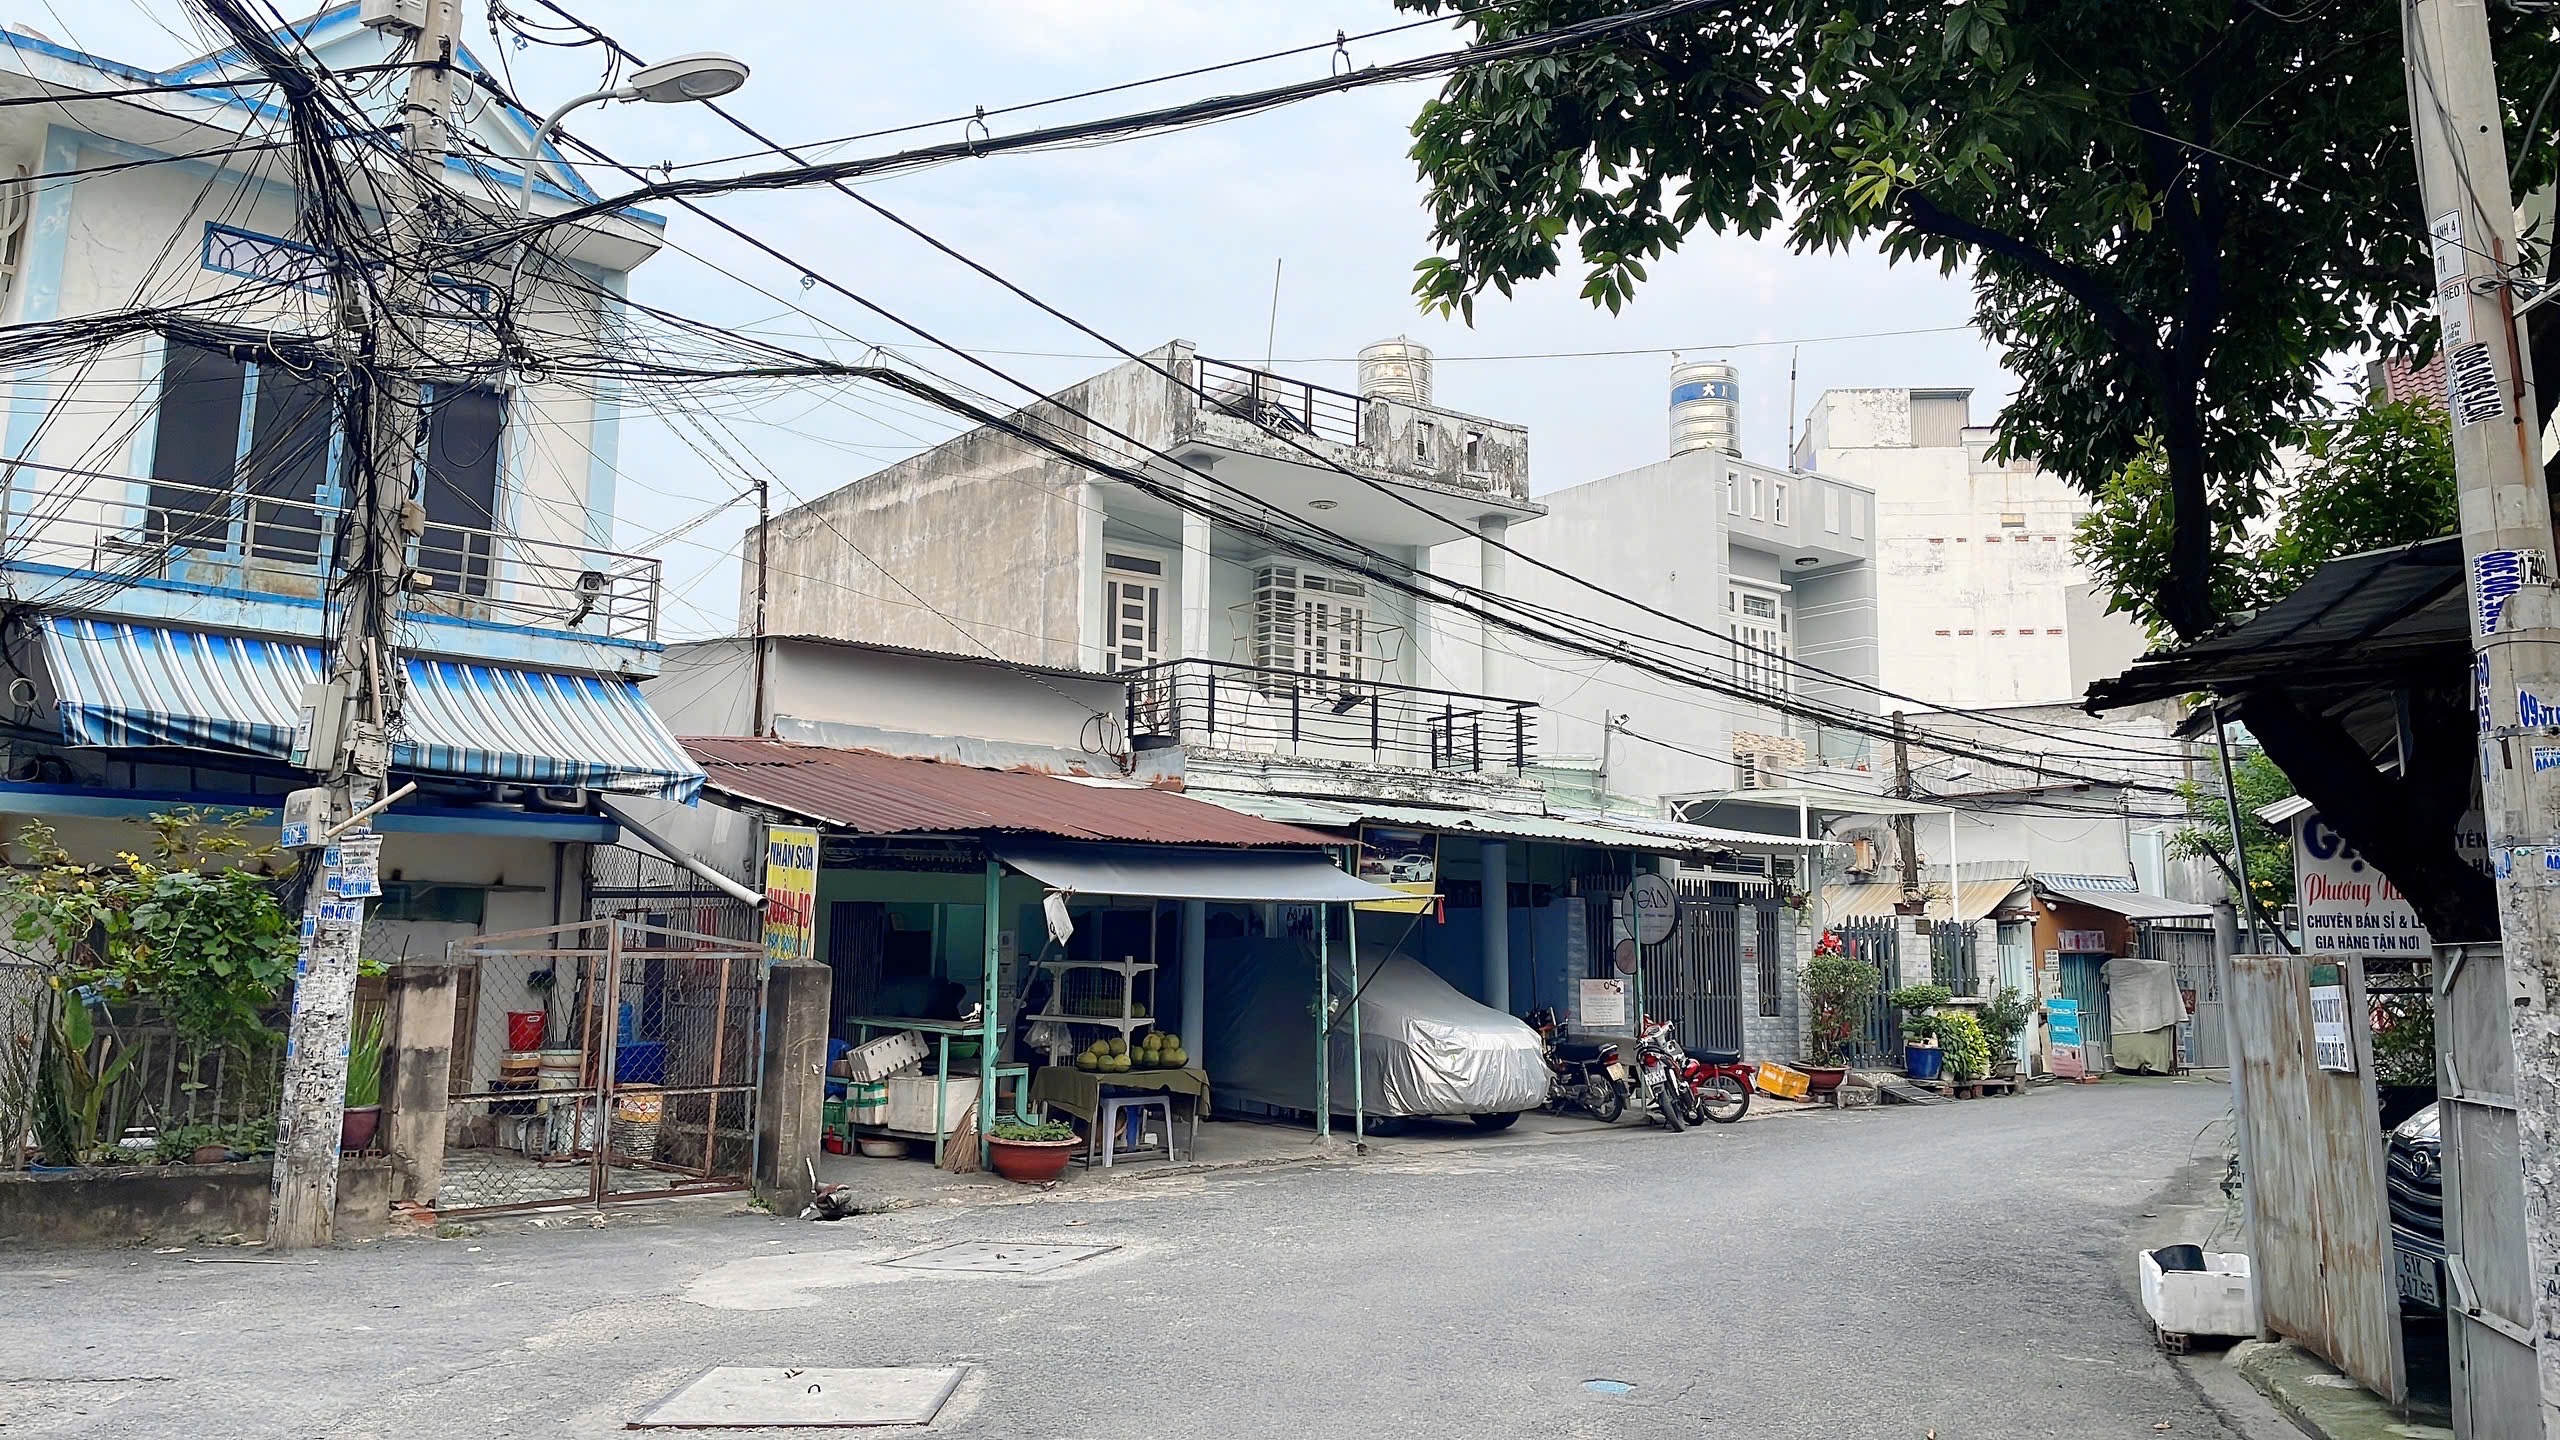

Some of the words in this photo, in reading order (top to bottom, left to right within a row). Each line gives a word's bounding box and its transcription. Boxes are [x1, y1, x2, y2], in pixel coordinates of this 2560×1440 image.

[769, 838, 794, 872] NHẬN
[795, 837, 813, 871] SỬA
[2304, 873, 2371, 908] Phương
[2307, 912, 2352, 929] CHUYÊN
[2355, 912, 2380, 929] BÁN
[2383, 911, 2394, 928] SỈ
[2398, 915, 2408, 928] &
[2315, 935, 2335, 949] GIA
[2338, 933, 2370, 949] HÀNG
[2372, 933, 2396, 952] TẬN
[2399, 935, 2420, 950] NƠI
